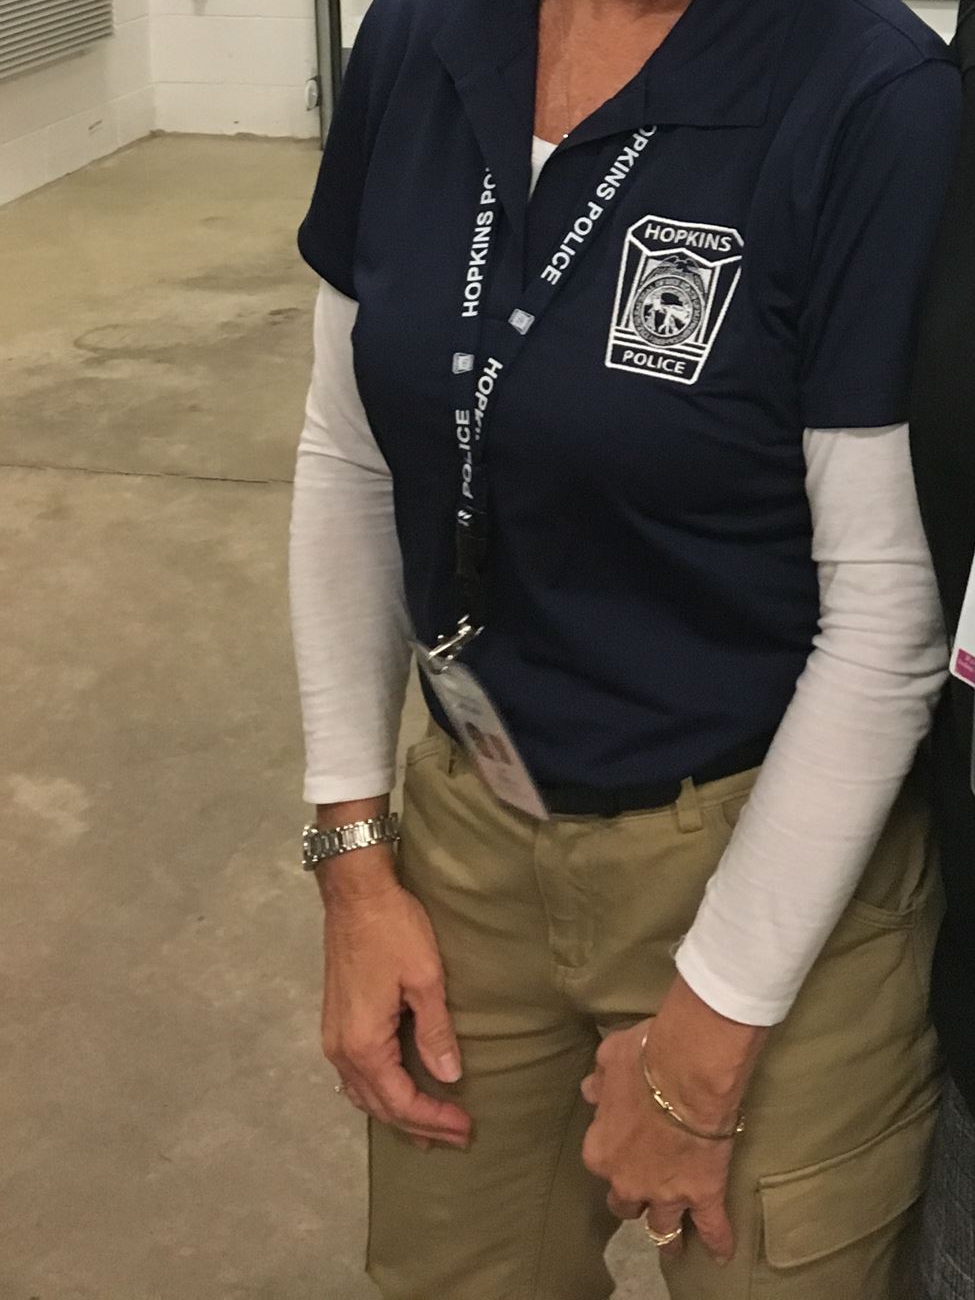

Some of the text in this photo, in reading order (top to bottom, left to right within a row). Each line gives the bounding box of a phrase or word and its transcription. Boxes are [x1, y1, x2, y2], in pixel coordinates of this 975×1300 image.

[461, 210, 494, 317] HOPKINS
[540, 202, 604, 285] POLICE
[644, 223, 733, 252] HOPKINS
[622, 350, 686, 375] POLICE
